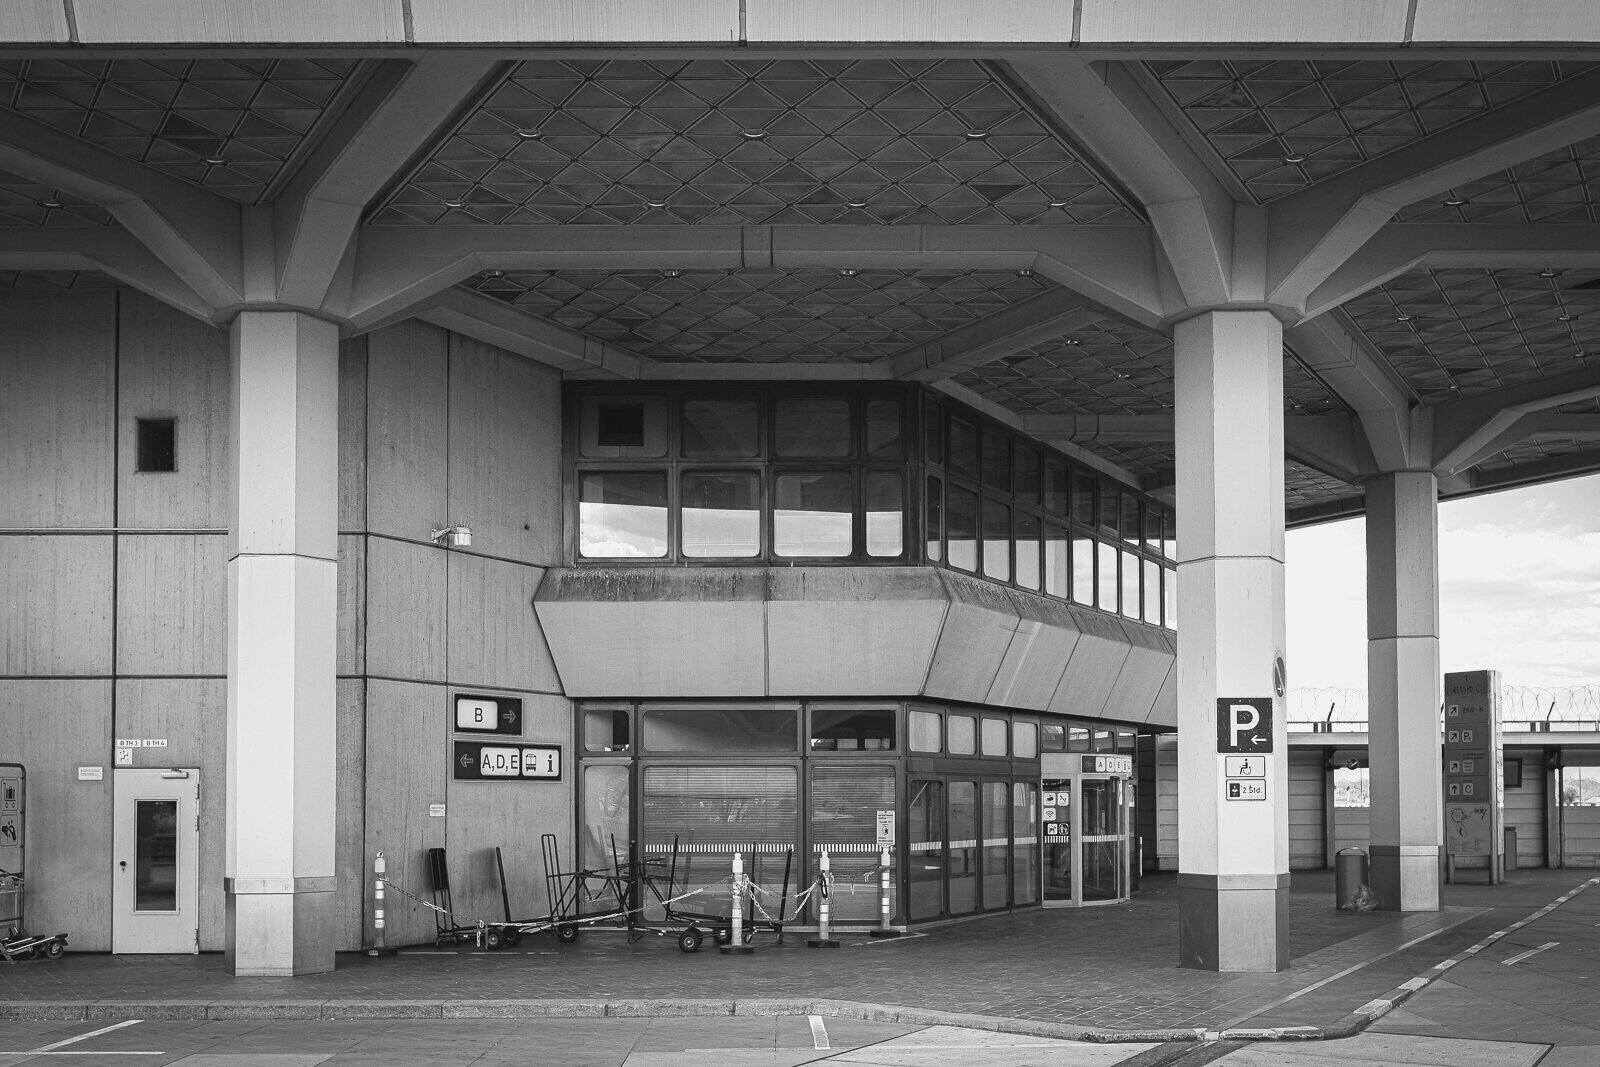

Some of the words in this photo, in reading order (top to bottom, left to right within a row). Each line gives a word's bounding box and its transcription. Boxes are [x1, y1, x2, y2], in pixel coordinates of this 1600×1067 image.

[474, 707, 483, 723] B
[1229, 704, 1260, 747] P
[1465, 785, 1472, 794] C
